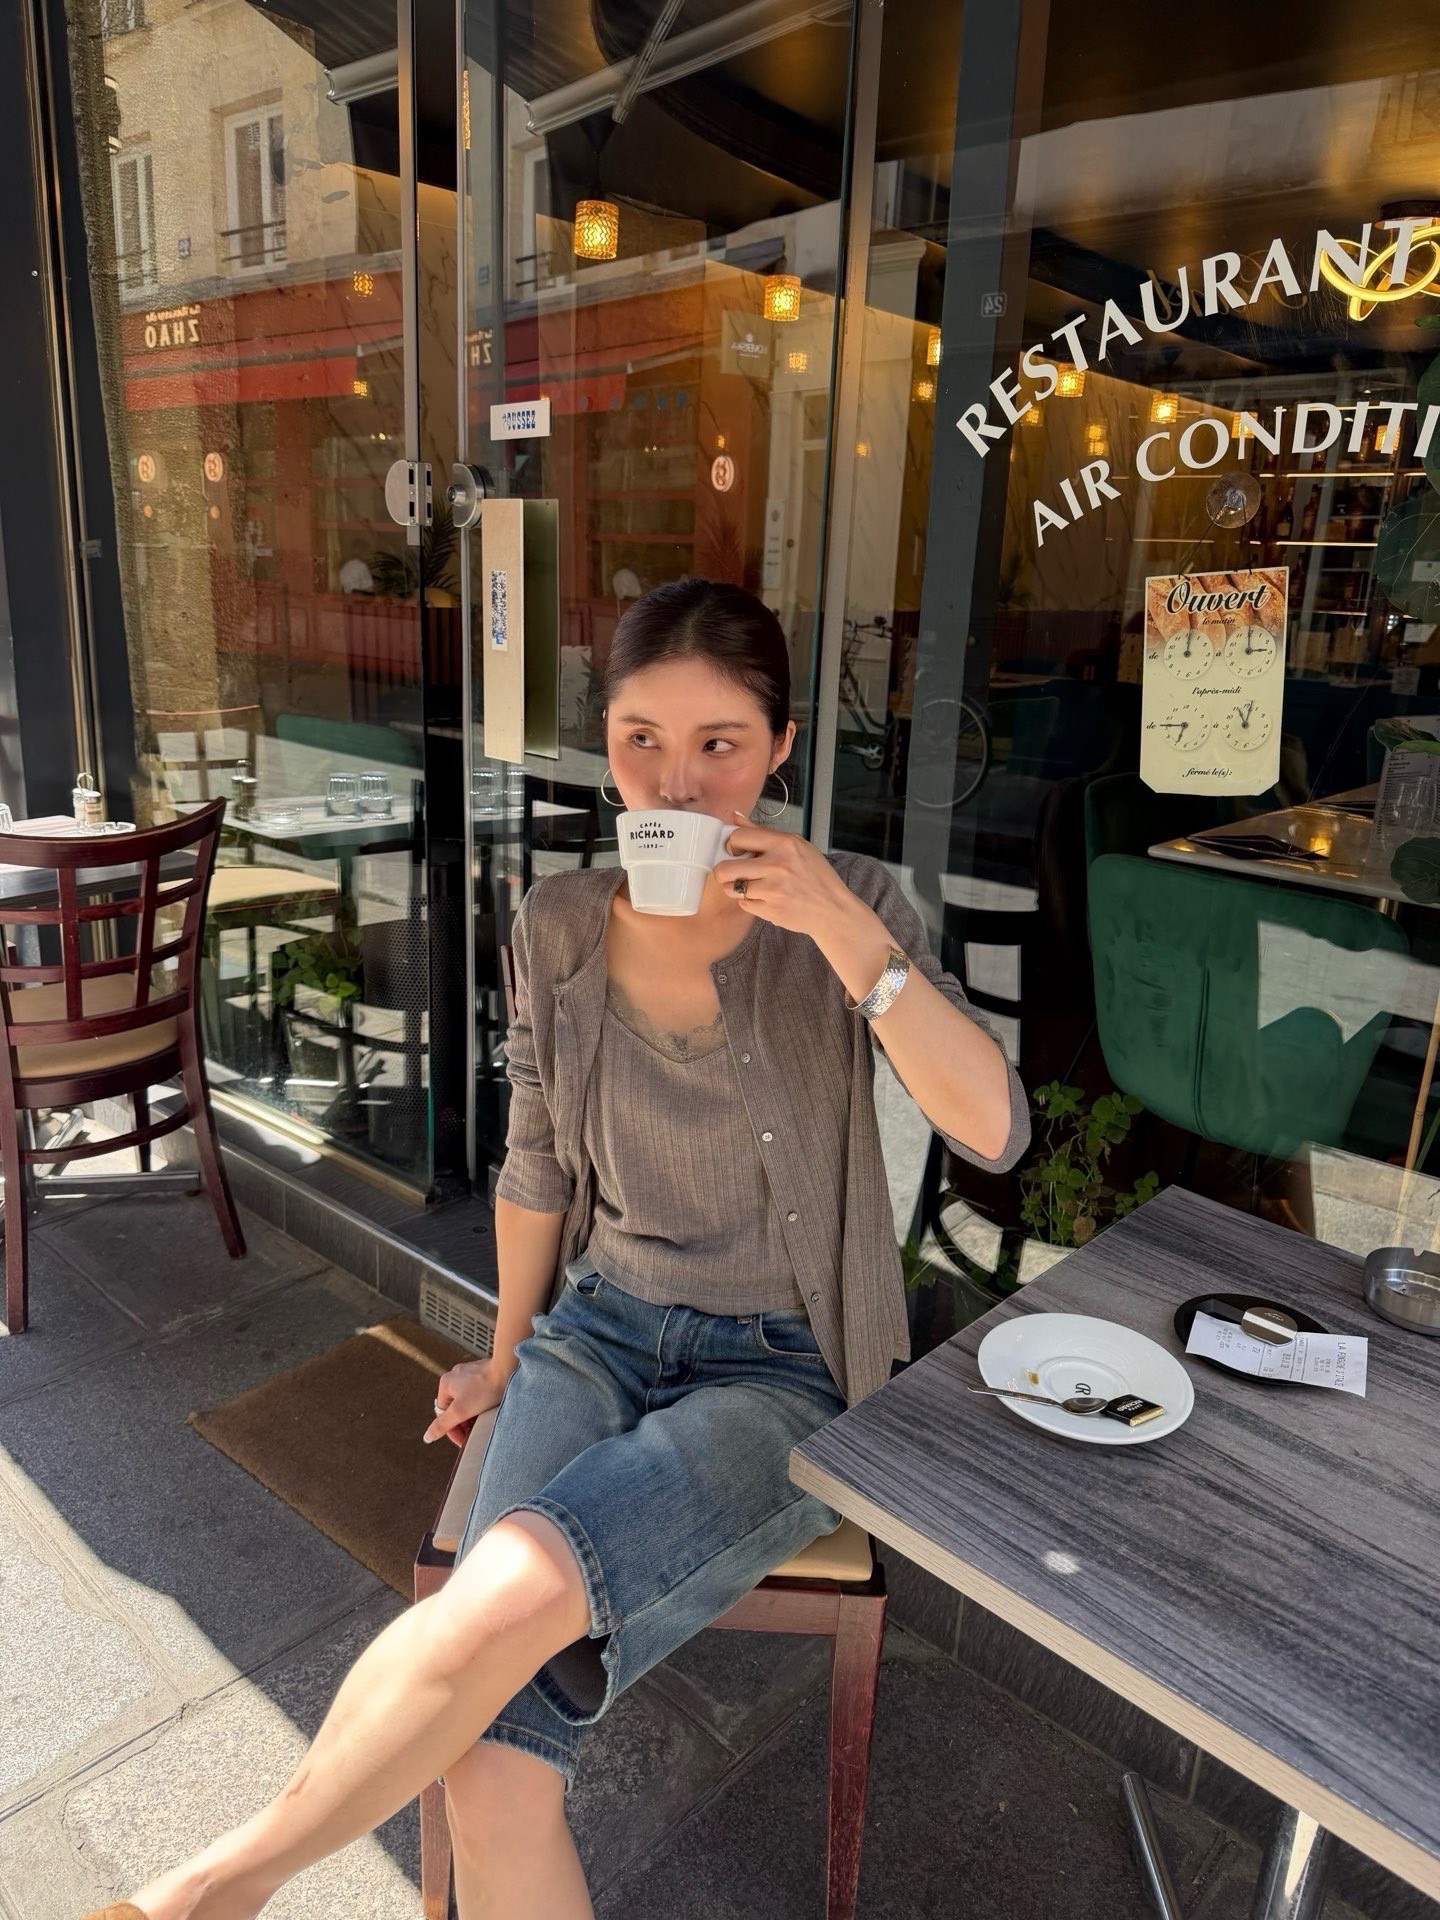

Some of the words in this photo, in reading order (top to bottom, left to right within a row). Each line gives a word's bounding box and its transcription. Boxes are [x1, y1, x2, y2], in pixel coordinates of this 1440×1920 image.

[956, 218, 1432, 458] RESTAURANT
[1032, 460, 1121, 547] AIR
[1136, 402, 1440, 482] CONDITI
[1166, 581, 1270, 613] Ouvert
[1211, 617, 1236, 625] matin
[1148, 651, 1158, 660] de
[1146, 722, 1157, 730] de
[630, 830, 674, 840] RICHARD
